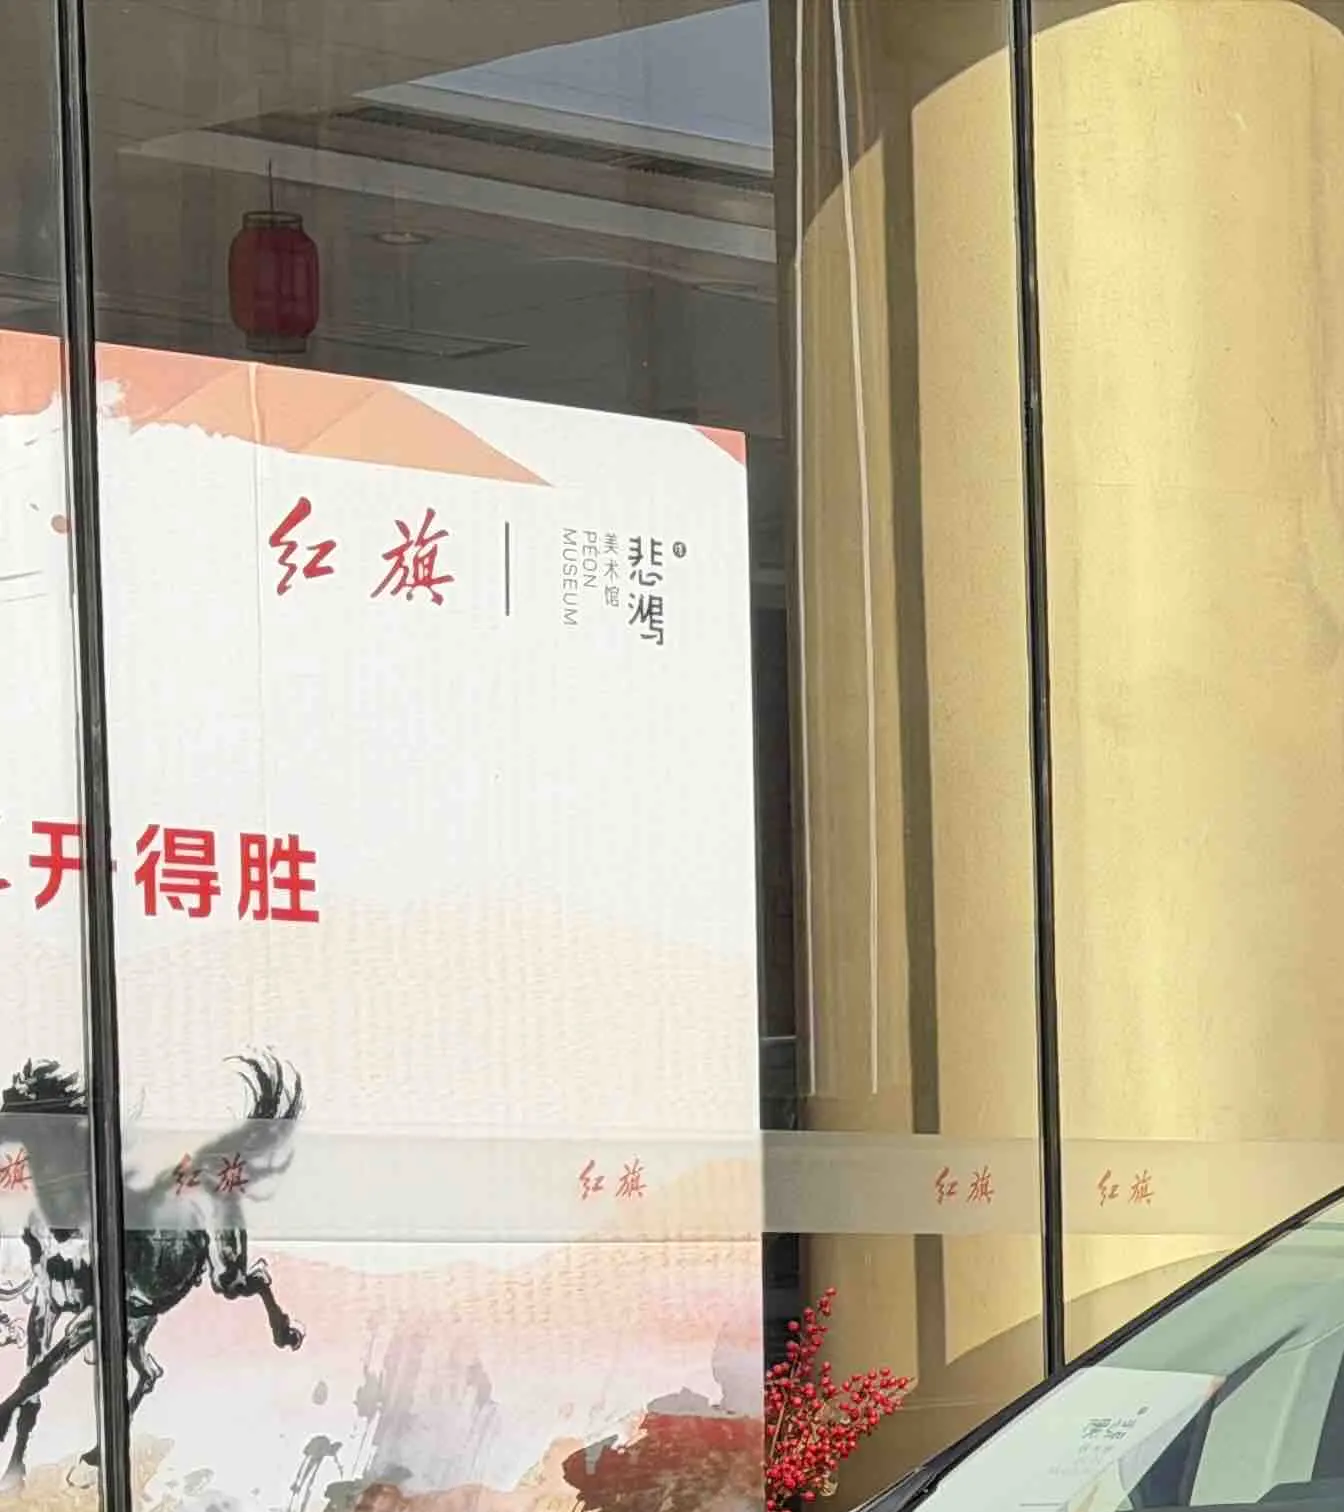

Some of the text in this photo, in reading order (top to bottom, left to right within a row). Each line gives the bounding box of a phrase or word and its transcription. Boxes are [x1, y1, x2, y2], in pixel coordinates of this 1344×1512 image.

[268, 496, 455, 606] 红旗
[562, 527, 579, 626] MUSEUM
[603, 531, 620, 608] 美术馆
[627, 535, 664, 646] 悲鸿
[173, 1152, 250, 1196] 红旗
[579, 1157, 648, 1200] 红旗
[934, 1164, 996, 1205] 红旗
[1097, 1168, 1155, 1206] 红旗
